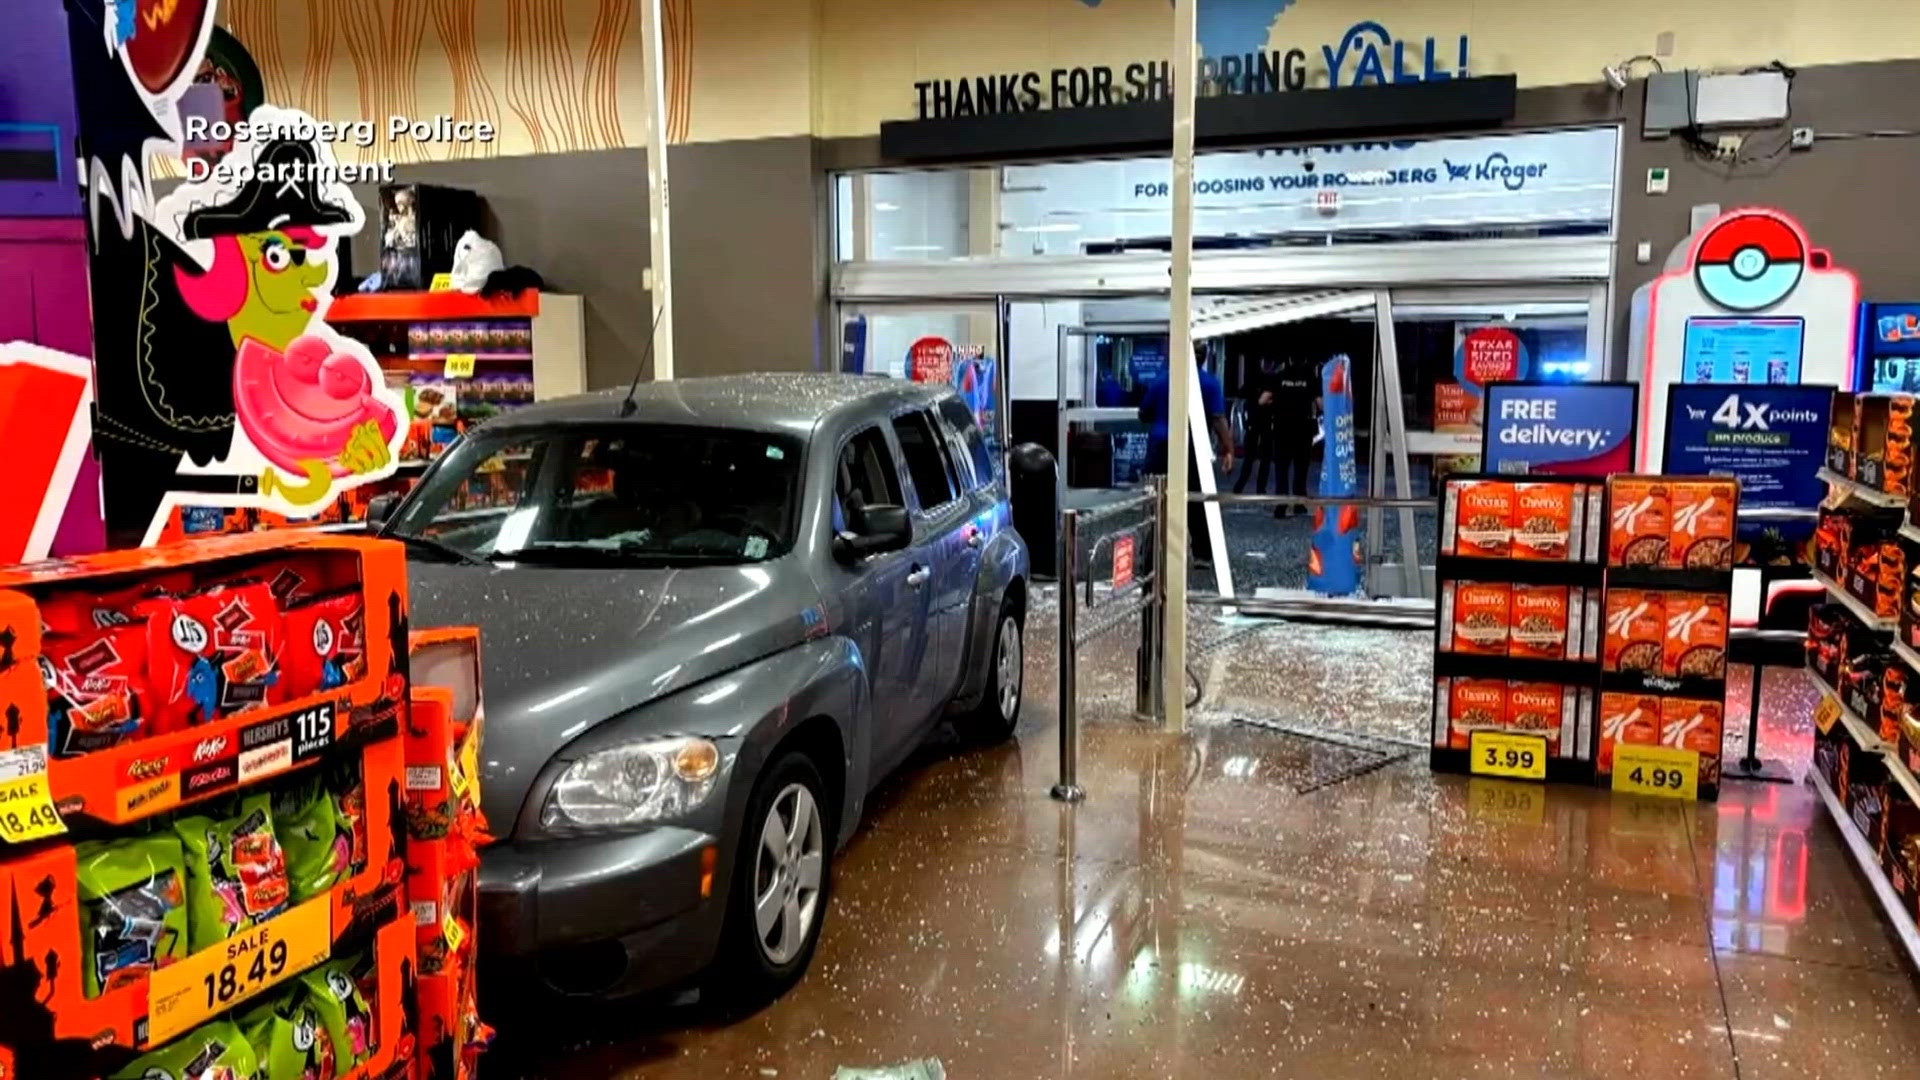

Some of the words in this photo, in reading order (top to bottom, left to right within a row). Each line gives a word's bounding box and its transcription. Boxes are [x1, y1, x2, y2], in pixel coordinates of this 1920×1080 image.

[914, 72, 1041, 119] THANKS
[1050, 66, 1113, 109] FOR
[1125, 47, 1306, 102] SHPPING
[1135, 183, 1169, 198] FOR
[1192, 177, 1265, 195] OOSING
[1269, 173, 1319, 191] YOUR
[1323, 167, 1438, 188] ROBERG
[1476, 152, 1548, 191] Kroger
[1500, 398, 1557, 420] FREE
[1769, 408, 1819, 423] points
[296, 706, 331, 741] 115
[298, 735, 329, 756] pieces
[1484, 748, 1534, 769] 3.99
[1628, 766, 1683, 790] 4.99
[0, 804, 57, 834] 18.49
[227, 928, 270, 960] SALE
[204, 938, 288, 1009] 18.49
